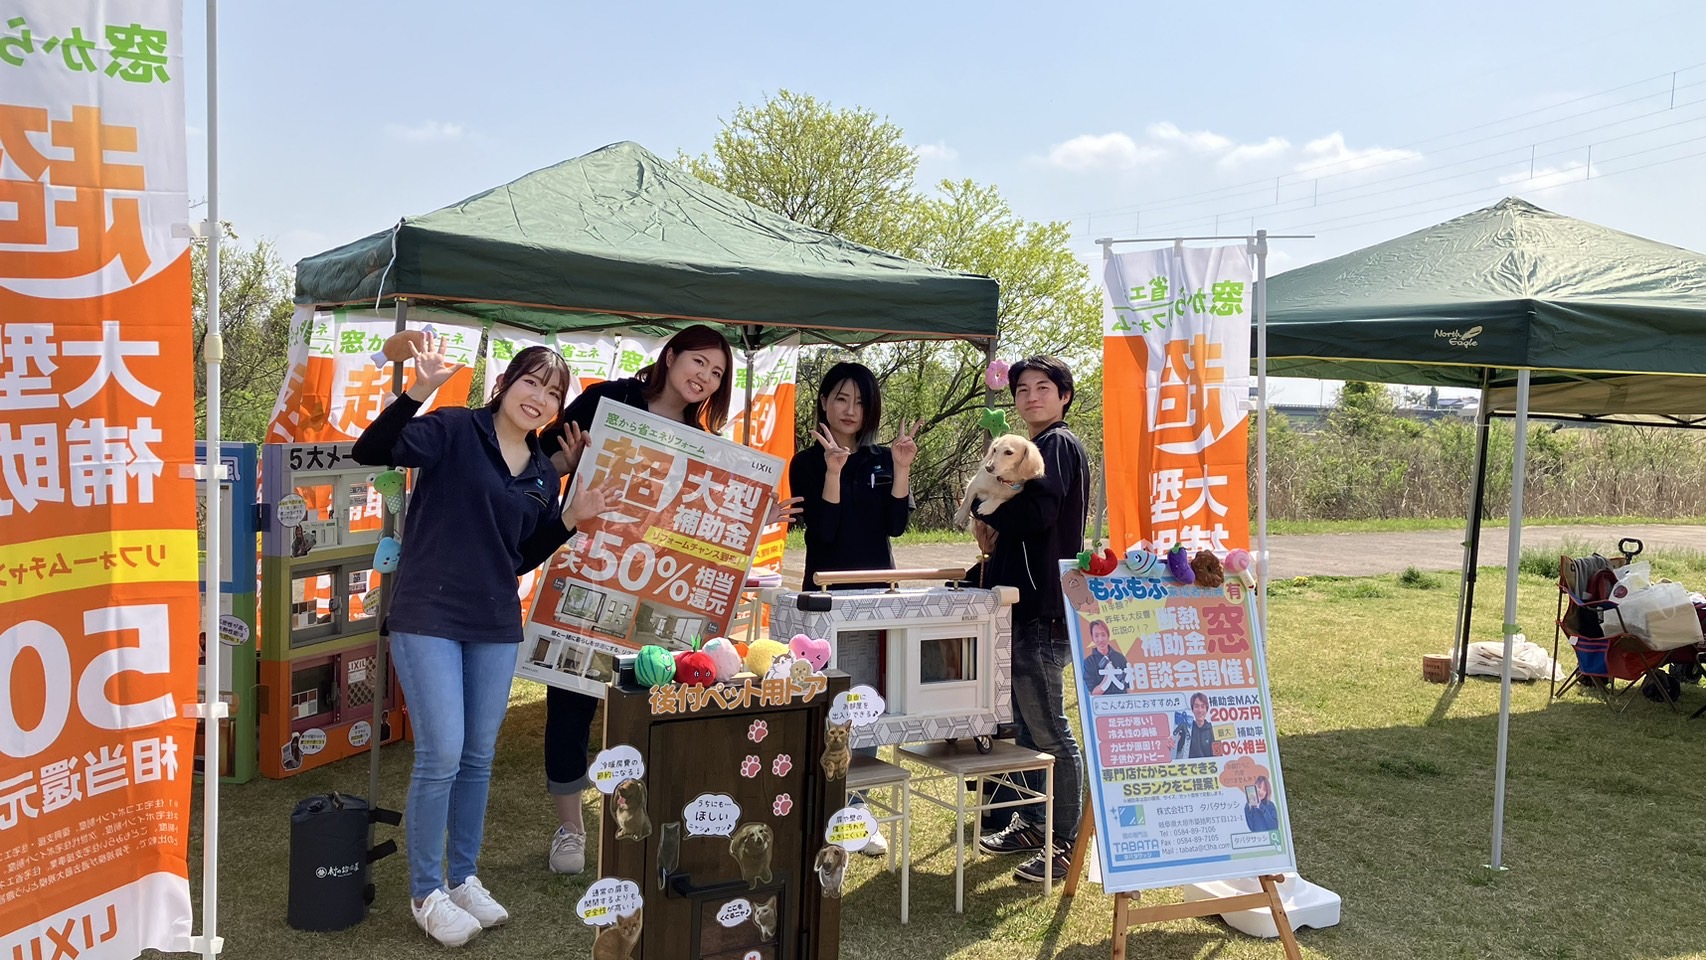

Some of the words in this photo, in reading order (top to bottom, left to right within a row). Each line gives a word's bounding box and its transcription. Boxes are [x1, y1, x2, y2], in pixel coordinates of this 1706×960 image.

[1434, 329, 1462, 338] North
[1449, 338, 1478, 348] Eagle
[561, 344, 600, 358] 省エネ
[605, 412, 706, 454] 窓から省エネリフォーム
[751, 461, 773, 474] LIXIL
[682, 470, 762, 524] 大型
[673, 504, 751, 551] 補助金
[580, 530, 694, 602] 50%
[695, 565, 736, 595] 相当
[1088, 577, 1168, 600] もふもふ
[1226, 582, 1242, 600] 有
[1155, 606, 1201, 630] 断熱
[1202, 603, 1249, 654] 窓
[1141, 631, 1206, 657] 補助金
[1098, 658, 1255, 691] 大相談会開催!
[649, 676, 828, 714] 後付ペット用ドア
[1209, 694, 1260, 707] 補助金MAX
[1210, 706, 1262, 722] 200万円
[1102, 761, 1218, 782] 専門店だからこそできる
[695, 811, 729, 822] ほしい
[1113, 839, 1160, 853] TABATA
